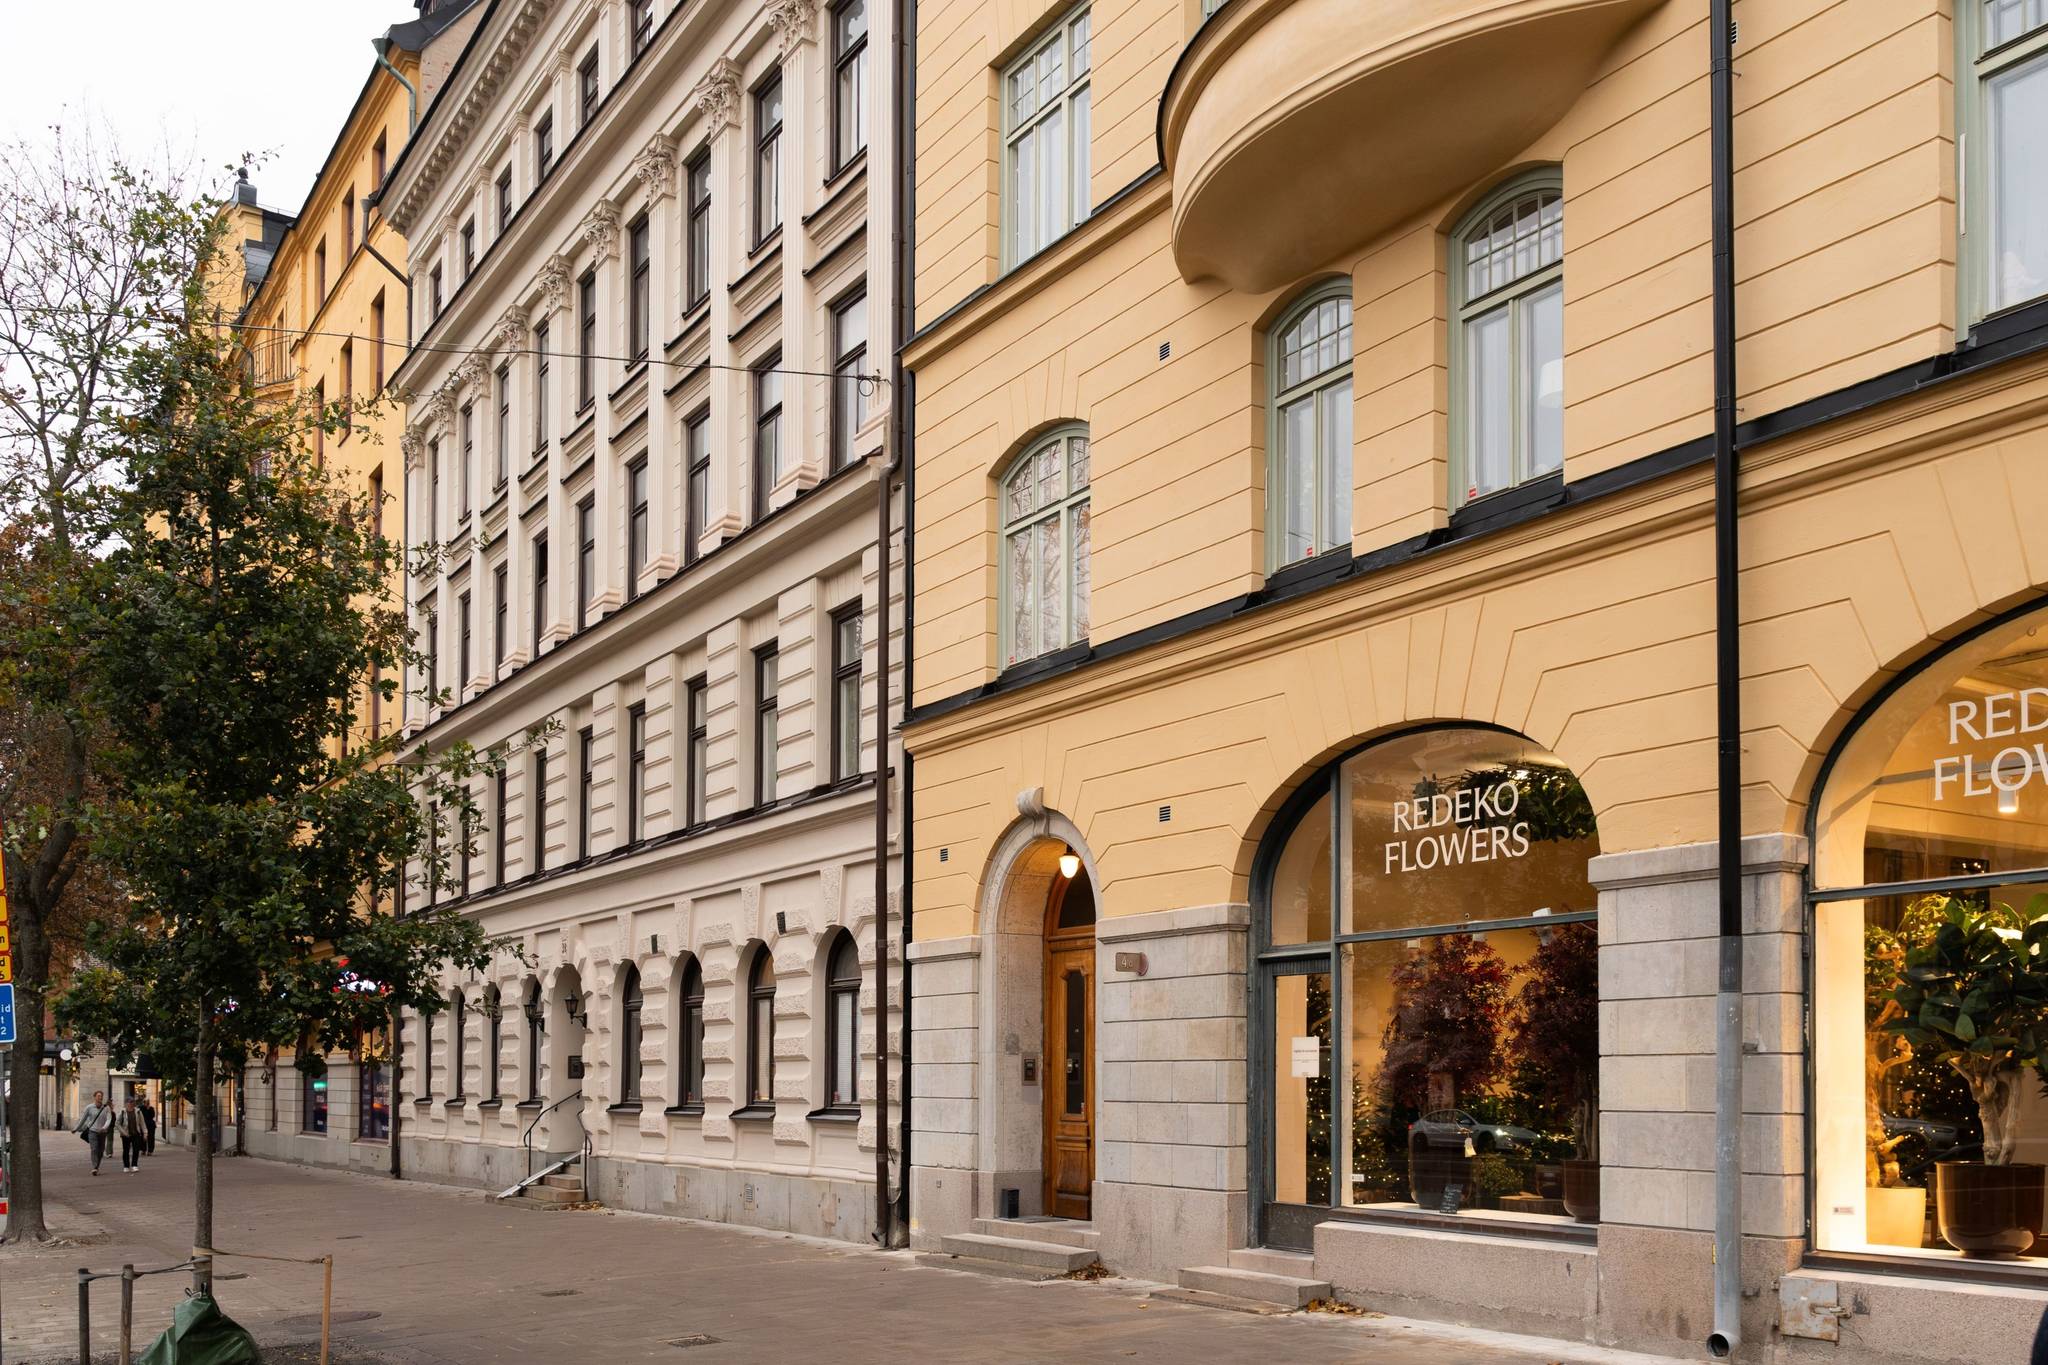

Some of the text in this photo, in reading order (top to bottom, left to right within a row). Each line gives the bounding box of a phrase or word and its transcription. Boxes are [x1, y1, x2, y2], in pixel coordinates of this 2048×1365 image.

[1933, 743, 2048, 801] FLO
[1393, 781, 1519, 833] REDEKO
[1384, 822, 1530, 875] FLOWERS
